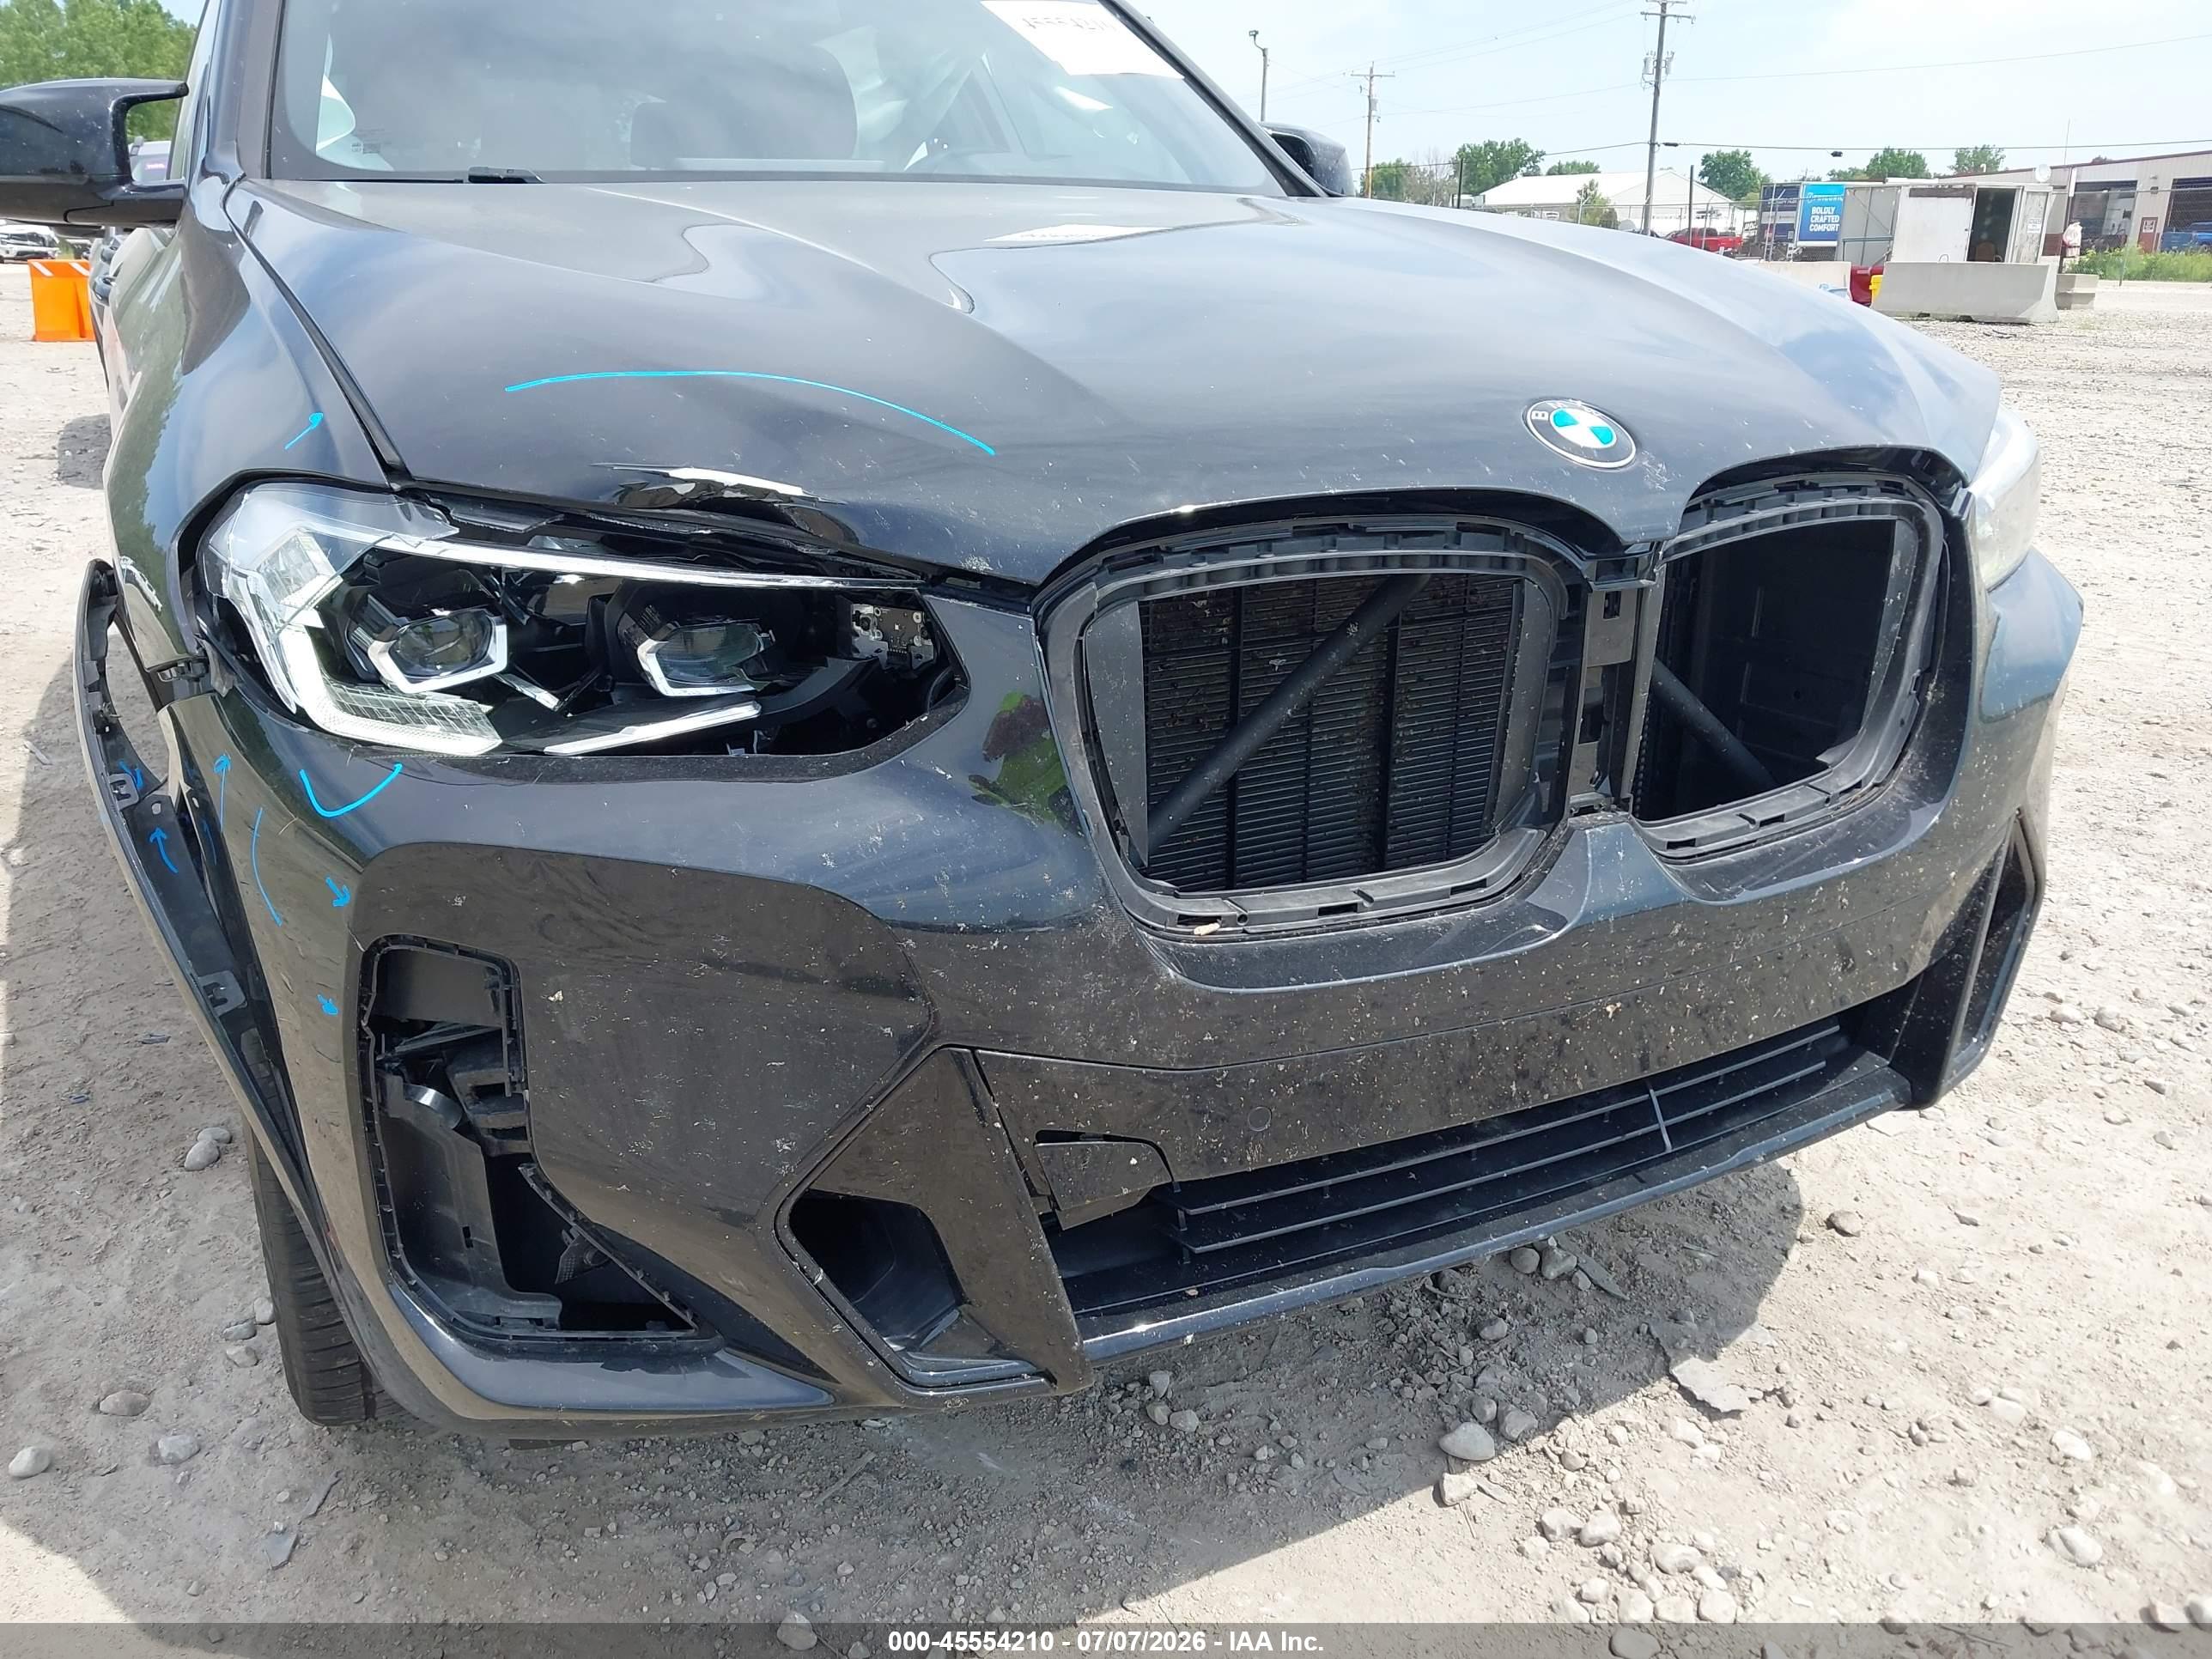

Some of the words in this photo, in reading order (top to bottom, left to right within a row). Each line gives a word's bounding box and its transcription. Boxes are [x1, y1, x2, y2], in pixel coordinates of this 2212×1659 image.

[1811, 206, 1835, 215] BOLDLY
[1810, 215, 1839, 223] CRAFTED
[1808, 223, 1839, 232] COMFORT
